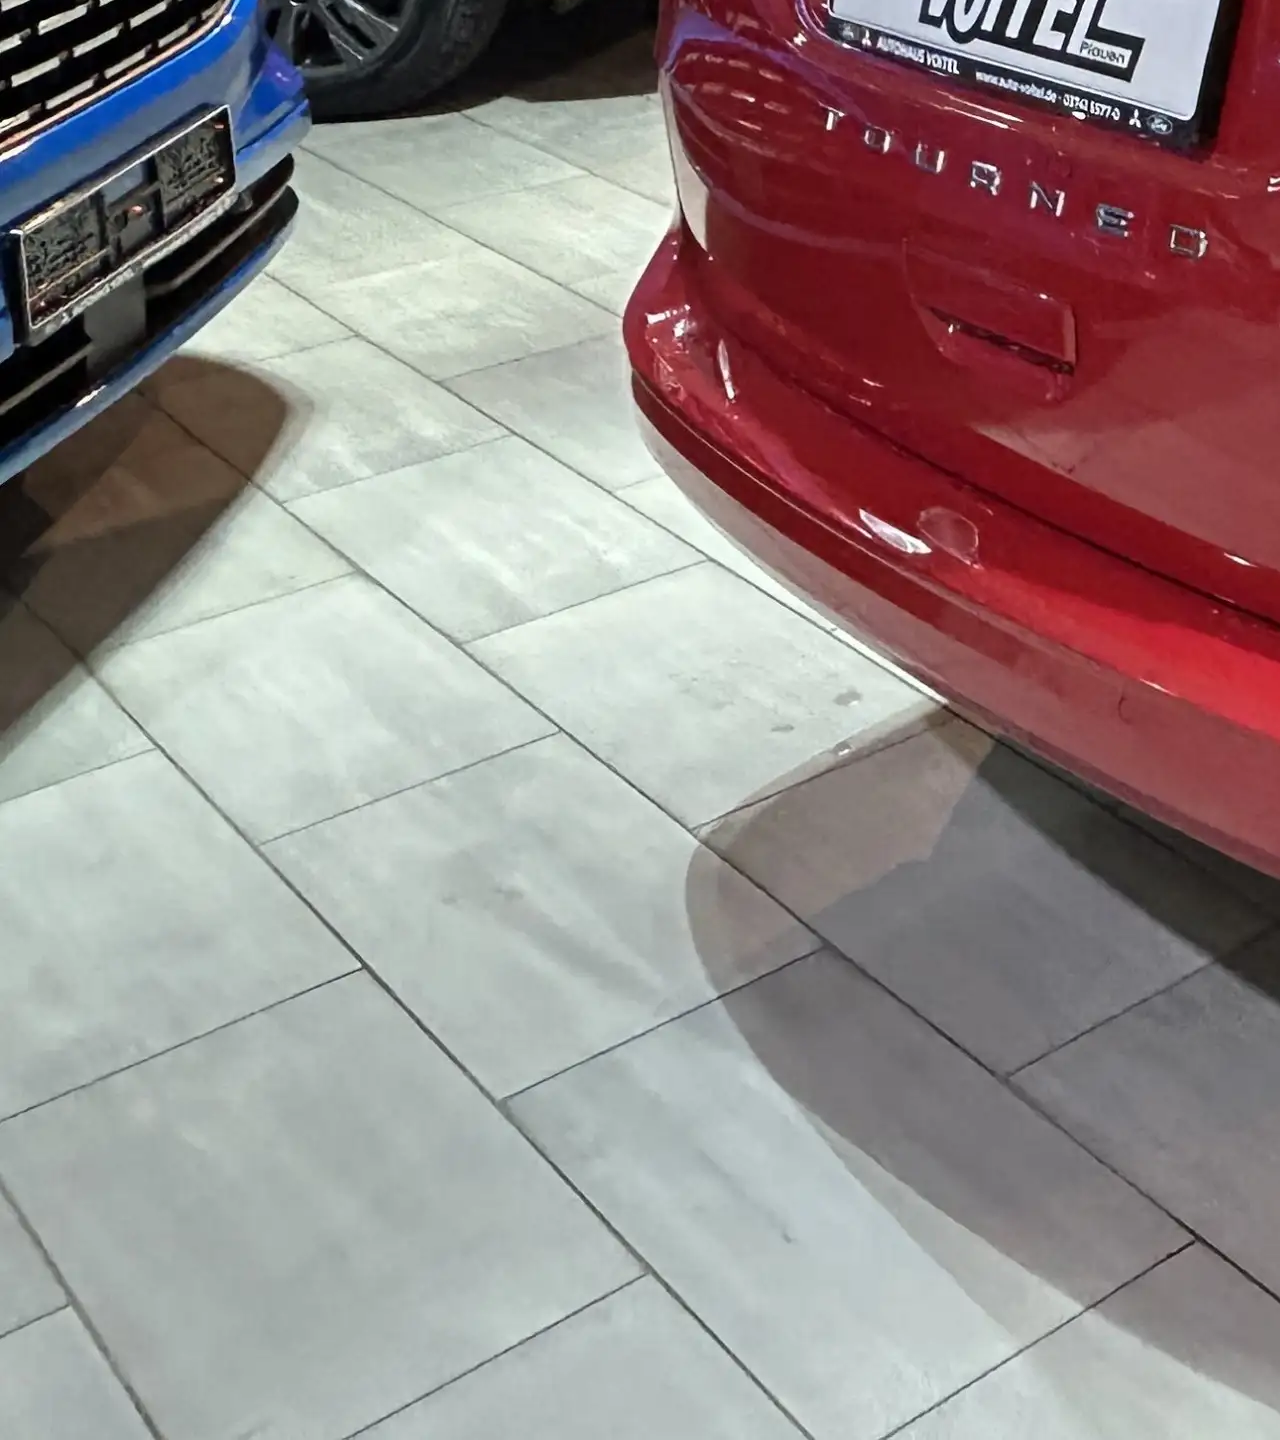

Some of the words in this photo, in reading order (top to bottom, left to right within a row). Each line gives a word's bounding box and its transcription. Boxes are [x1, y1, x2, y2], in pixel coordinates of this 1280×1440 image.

[876, 36, 925, 63] AUTOHAUS
[926, 49, 960, 74] VOITEL
[1079, 40, 1126, 64] Plauen
[822, 107, 1208, 258] TOURNEO
